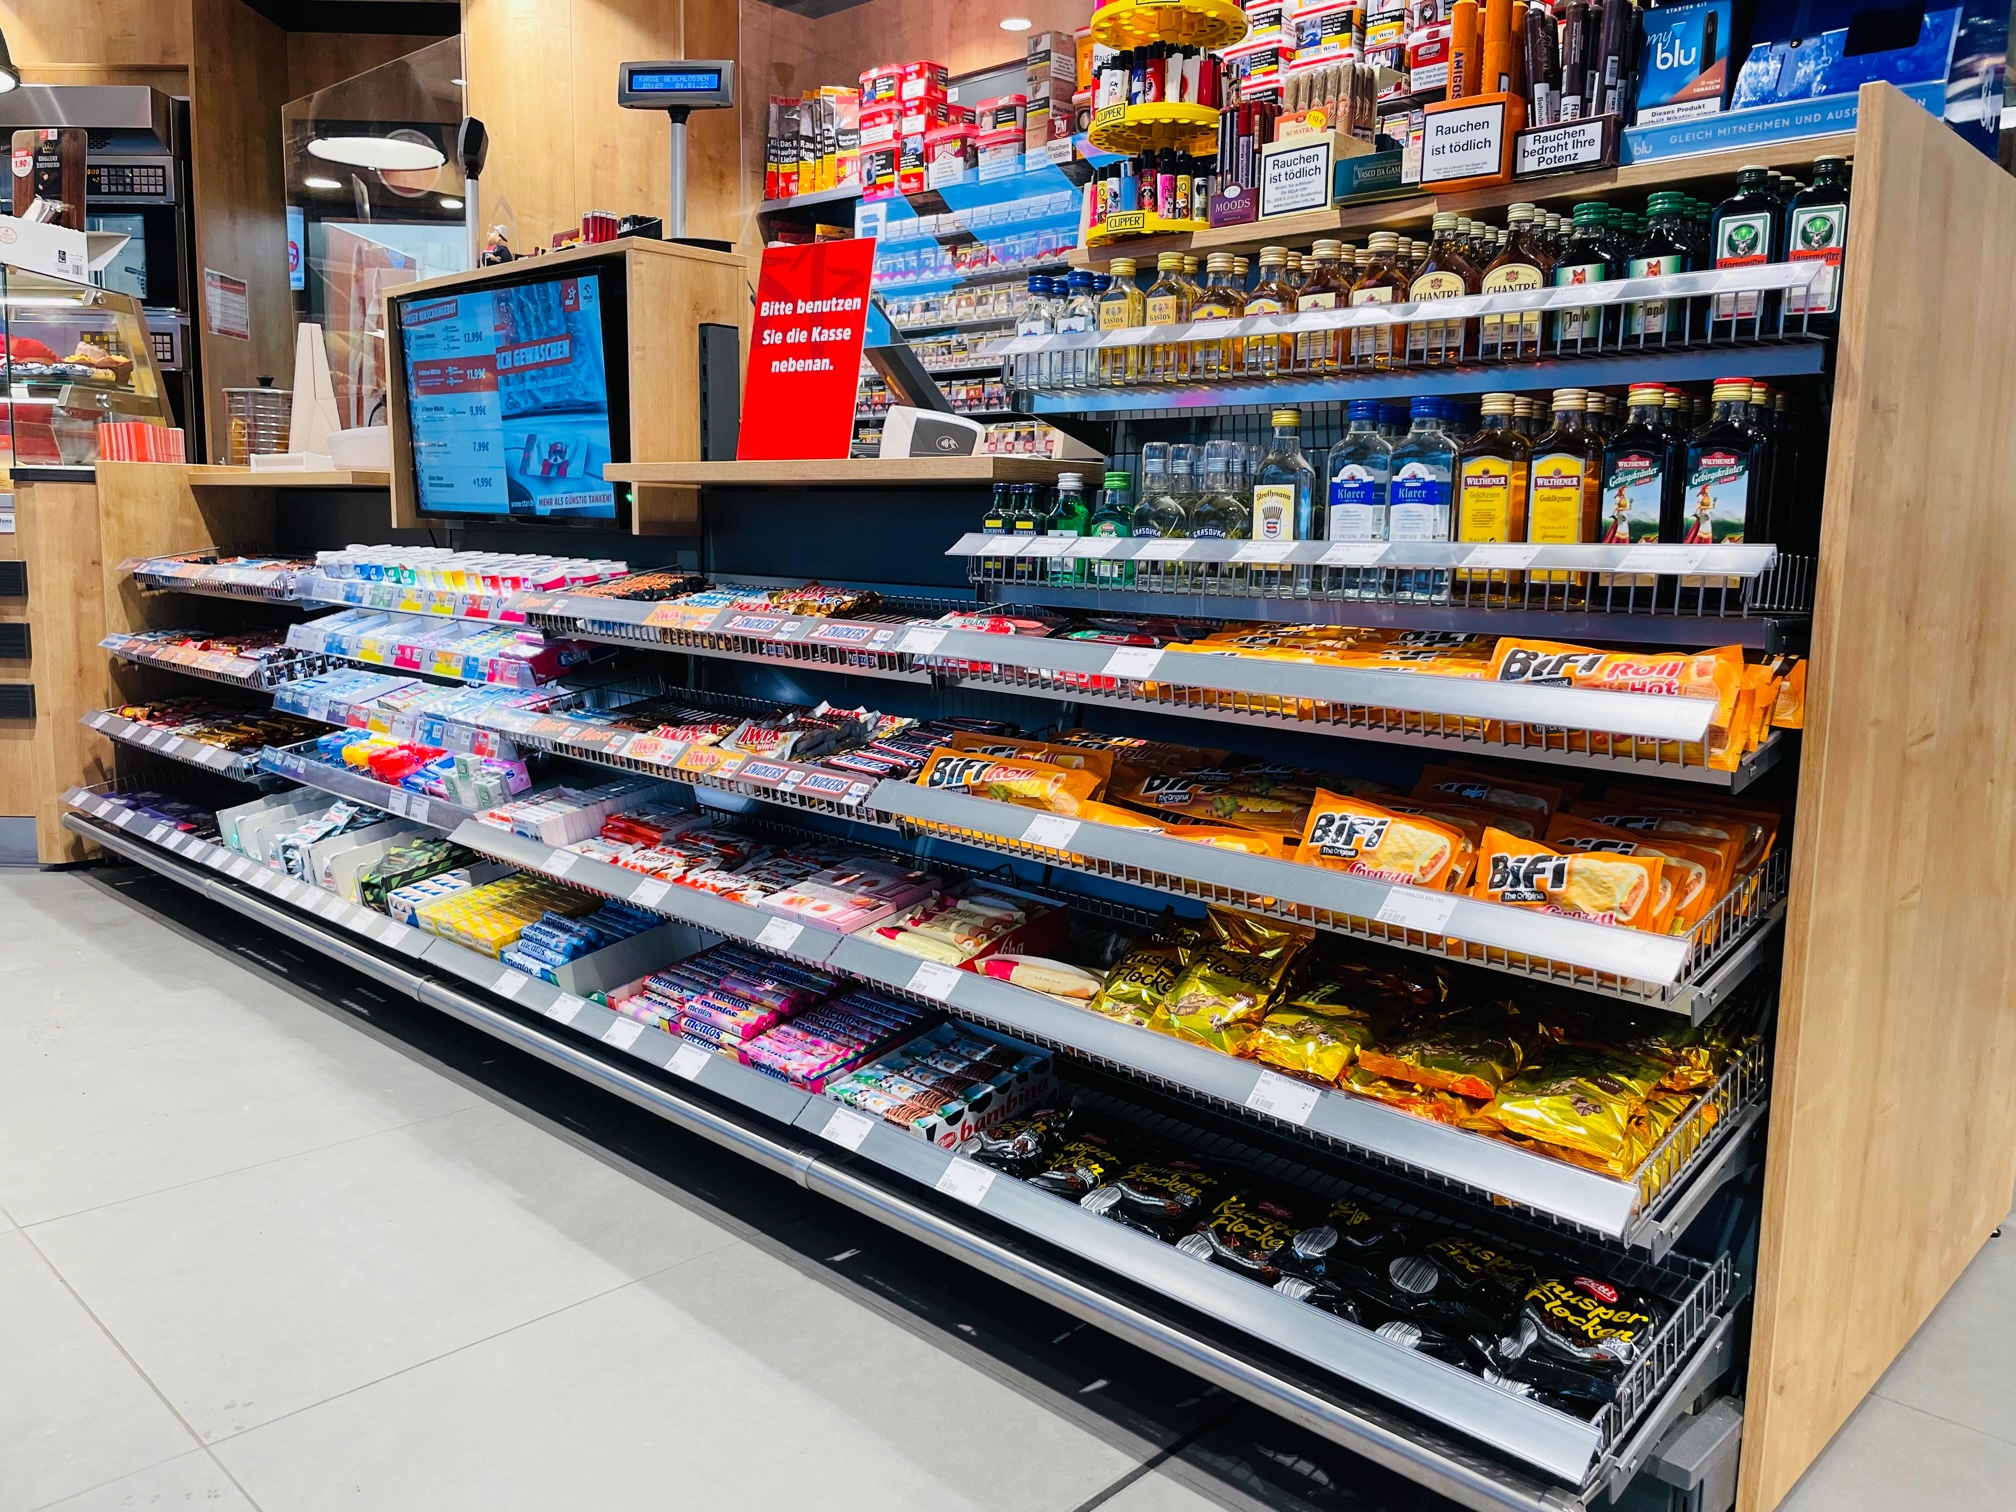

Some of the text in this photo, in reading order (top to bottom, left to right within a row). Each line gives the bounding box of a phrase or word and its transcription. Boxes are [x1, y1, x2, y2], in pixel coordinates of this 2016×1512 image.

[1666, 5, 1693, 14] STARTER
[1646, 30, 1673, 49] my
[1656, 39, 1696, 70] blu
[1452, 52, 1464, 99] AMIGOS
[1693, 85, 1720, 93] TOBACCO
[1098, 107, 1122, 122] CLIPPER
[1652, 104, 1705, 118] Dieses Produkt
[1286, 127, 1314, 136] SUMATRA
[1436, 120, 1489, 136] Rauchen
[1670, 129, 1712, 145] GLEICH
[1717, 118, 1790, 137] MITNEHMEN
[1795, 112, 1821, 125] UND
[1533, 128, 1585, 145] Rauchen
[1048, 144, 1069, 152] Rauchen
[1432, 138, 1491, 156] ist tödlich
[1523, 137, 1595, 158] bedroht Ihre
[1633, 141, 1652, 156] blu
[1272, 154, 1319, 170] Rauchen
[1537, 153, 1578, 167] Potenz
[1269, 165, 1321, 184] ist tödlich
[1216, 198, 1250, 212] MOODS
[1110, 218, 1140, 228] CLIPPER
[1414, 287, 1460, 301] CHANTRÉ
[1487, 280, 1538, 294] CHANTRÉ
[760, 298, 862, 316] Bitte benutzen
[762, 326, 852, 345] Sie die Kasse
[771, 357, 834, 373] nebenan.
[470, 406, 486, 415] 9,99€
[473, 442, 489, 451] 7,99€
[1467, 477, 1505, 485] WILTHENER
[1537, 477, 1577, 486] WILTHENER
[1609, 467, 1658, 487] Gebirgskräuter
[1692, 465, 1745, 485] Gebirgskräuter
[539, 494, 611, 506] MEHR ALS GÜNSTIG TANKEN!
[1256, 489, 1291, 501] Strothmann
[1338, 489, 1365, 498] Klarer
[1399, 488, 1427, 498] Klarer
[1133, 528, 1161, 537] GRASOVKA
[1193, 528, 1226, 538] GRASOVKA
[724, 615, 779, 631] 2 SNICKERS
[810, 624, 870, 641] 2 SNICKERS
[1607, 662, 1686, 678] Roll
[1629, 680, 1679, 695] Hot
[743, 763, 786, 779] SNICKERS
[987, 767, 1037, 782] Roll
[803, 775, 848, 792] SNICKERS
[1320, 847, 1357, 858] The Original
[1348, 861, 1415, 885] Carazza
[1504, 891, 1546, 901] The Original
[520, 940, 547, 957] mentos
[649, 976, 685, 994] mentos
[712, 992, 750, 1011] mentos
[687, 1004, 713, 1018] mentos
[684, 1018, 723, 1040] mentos
[807, 1013, 850, 1034] mentos
[1275, 1077, 1316, 1093] KNUSPERFLOCKEN
[961, 1078, 1049, 1142] bambina
[1536, 1276, 1649, 1324] Knusper
[1524, 1289, 1634, 1342] Flocken
